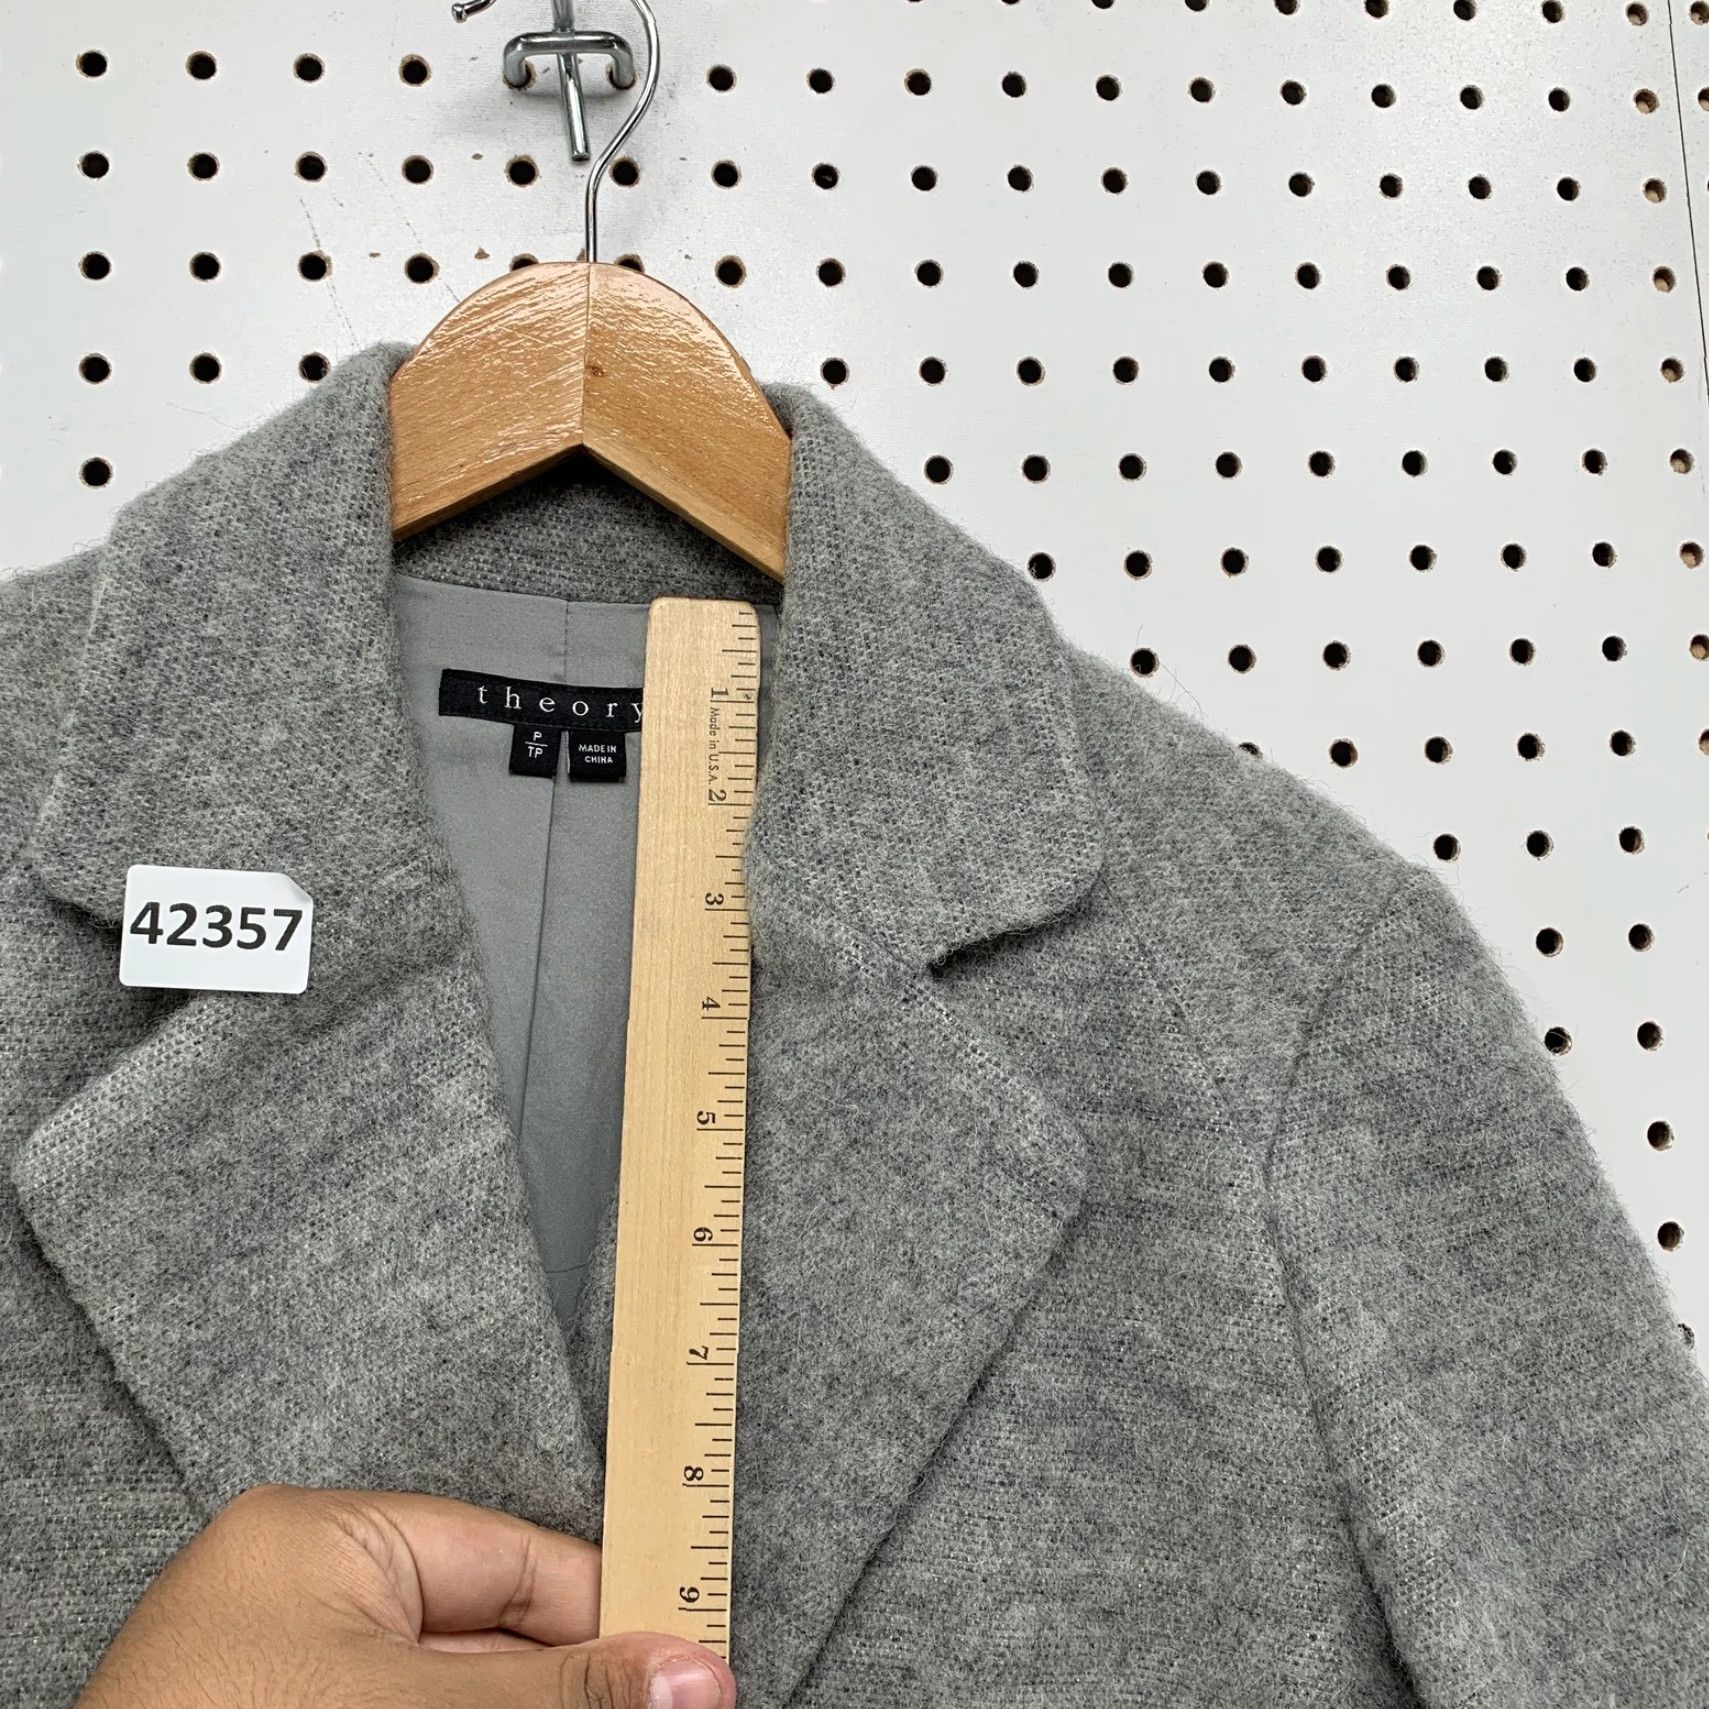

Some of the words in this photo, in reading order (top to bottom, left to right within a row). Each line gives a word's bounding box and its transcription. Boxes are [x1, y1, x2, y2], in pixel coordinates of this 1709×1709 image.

[710, 687, 729, 699] 1
[476, 685, 643, 723] theory
[708, 707, 721, 737] Made
[532, 731, 543, 741] P
[527, 746, 544, 759] TP
[578, 744, 605, 753] MADE
[606, 745, 617, 754] IN
[708, 740, 720, 750] in
[584, 756, 614, 764] CHINA
[708, 754, 720, 785] U.S.A.
[708, 789, 727, 802] 2
[704, 892, 725, 906] 3
[130, 901, 303, 951] 42357
[701, 996, 721, 1011] 4
[696, 1110, 716, 1125] 5
[693, 1226, 714, 1242] 6
[688, 1345, 709, 1361] 7
[683, 1465, 704, 1481] 8
[679, 1586, 700, 1603] 9
